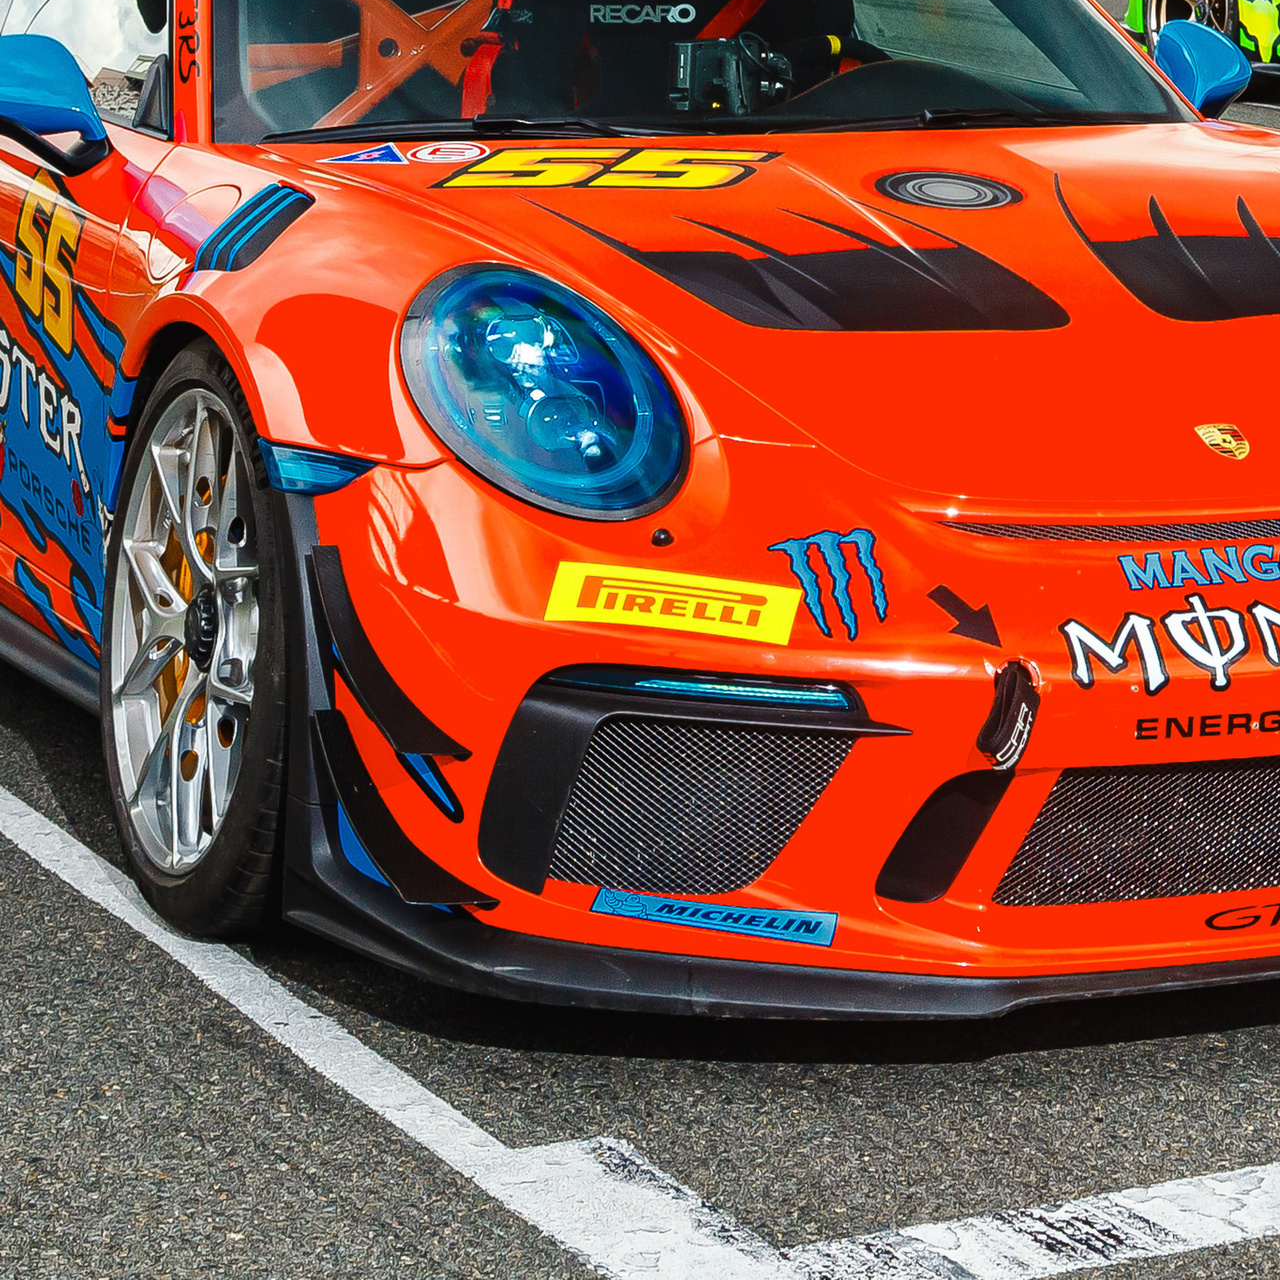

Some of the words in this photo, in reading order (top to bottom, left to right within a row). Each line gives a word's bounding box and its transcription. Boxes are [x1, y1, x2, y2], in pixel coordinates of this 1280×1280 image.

[590, 3, 696, 24] RECARO
[432, 147, 775, 188] 55
[15, 167, 82, 356] 55
[8, 447, 93, 557] PORSCHE
[576, 575, 768, 628] PIRELLI
[654, 902, 824, 936] MICHELIN
